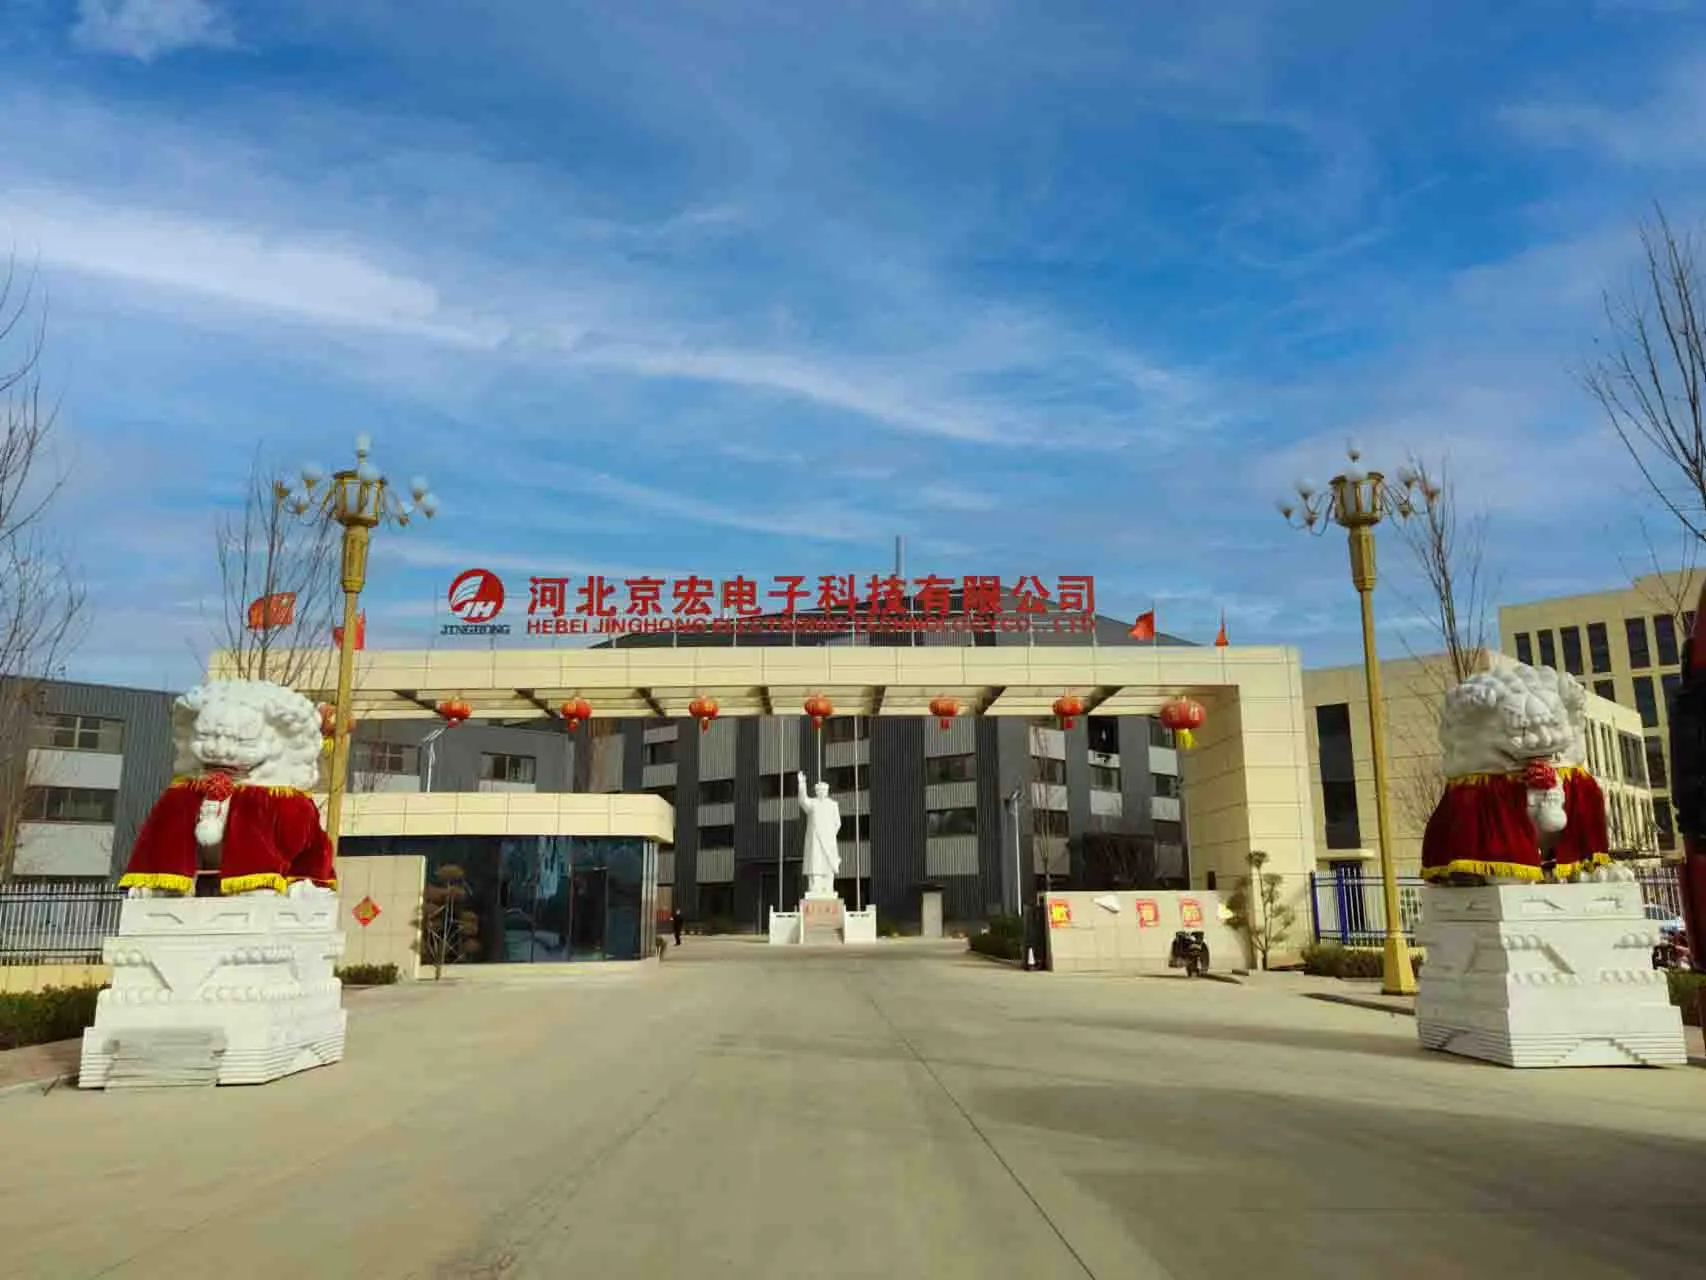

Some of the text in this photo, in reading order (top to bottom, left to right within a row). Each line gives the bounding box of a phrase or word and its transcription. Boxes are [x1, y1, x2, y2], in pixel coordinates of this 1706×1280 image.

[527, 575, 1095, 617] 河北京宏电子科技有限公司
[440, 624, 511, 635] JINGHONG
[527, 618, 588, 634] HEBEI
[592, 618, 706, 634] JINGHONG
